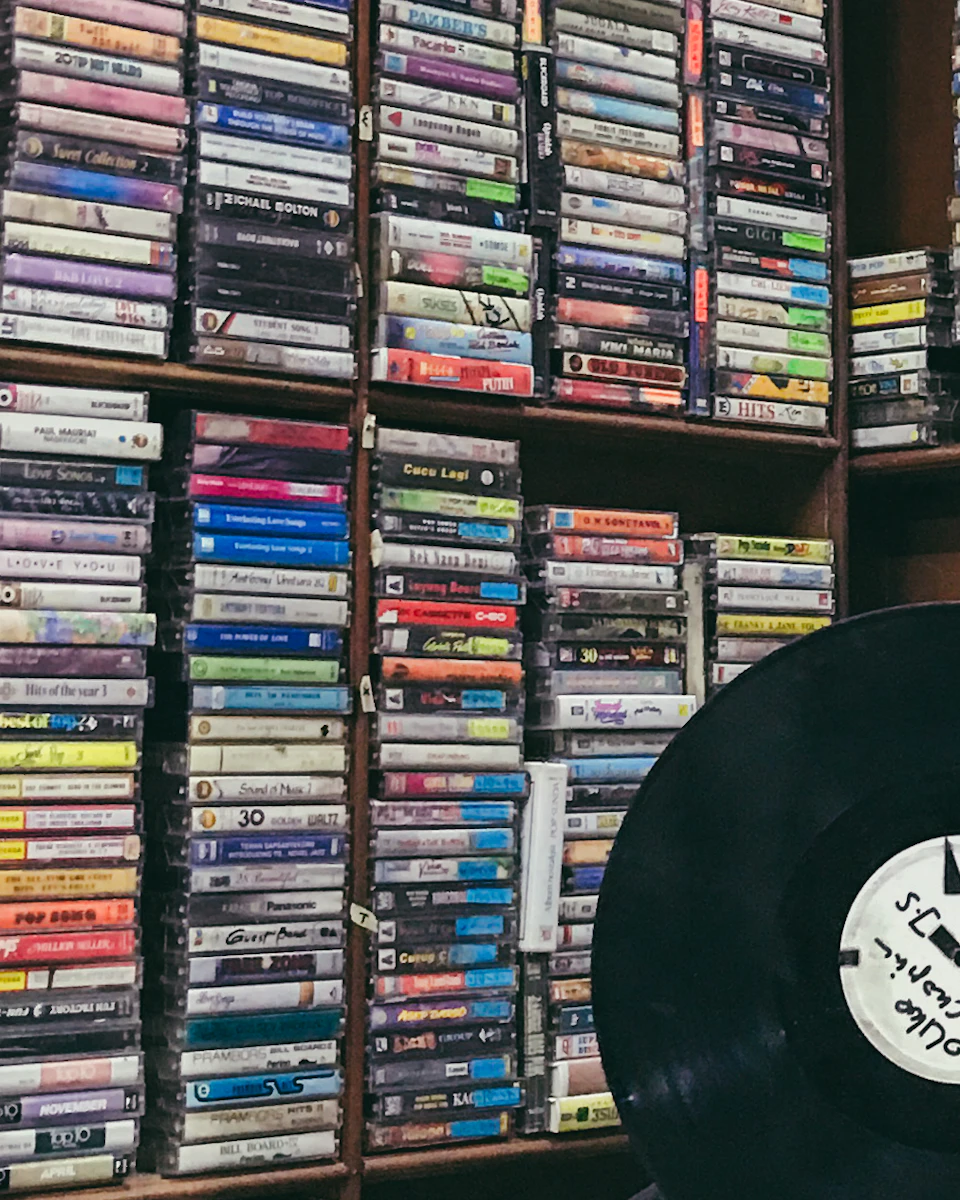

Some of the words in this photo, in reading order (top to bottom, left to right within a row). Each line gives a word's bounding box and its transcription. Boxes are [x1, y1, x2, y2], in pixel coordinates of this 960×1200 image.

[52, 147, 82, 160] Sweet
[85, 149, 137, 170] Collection
[223, 191, 271, 210] MICHAEL
[274, 201, 318, 218] BOLTON
[738, 402, 775, 420] HITS
[34, 426, 57, 437] PAUL
[59, 427, 97, 438] MAURIAT
[25, 683, 45, 697] Hits
[59, 683, 75, 697] the
[238, 808, 265, 828] 30
[266, 900, 317, 911] Panasonic
[358, 912, 370, 924] T
[39, 1098, 108, 1117] NOVEMBER
[40, 1165, 77, 1180] APRIL
